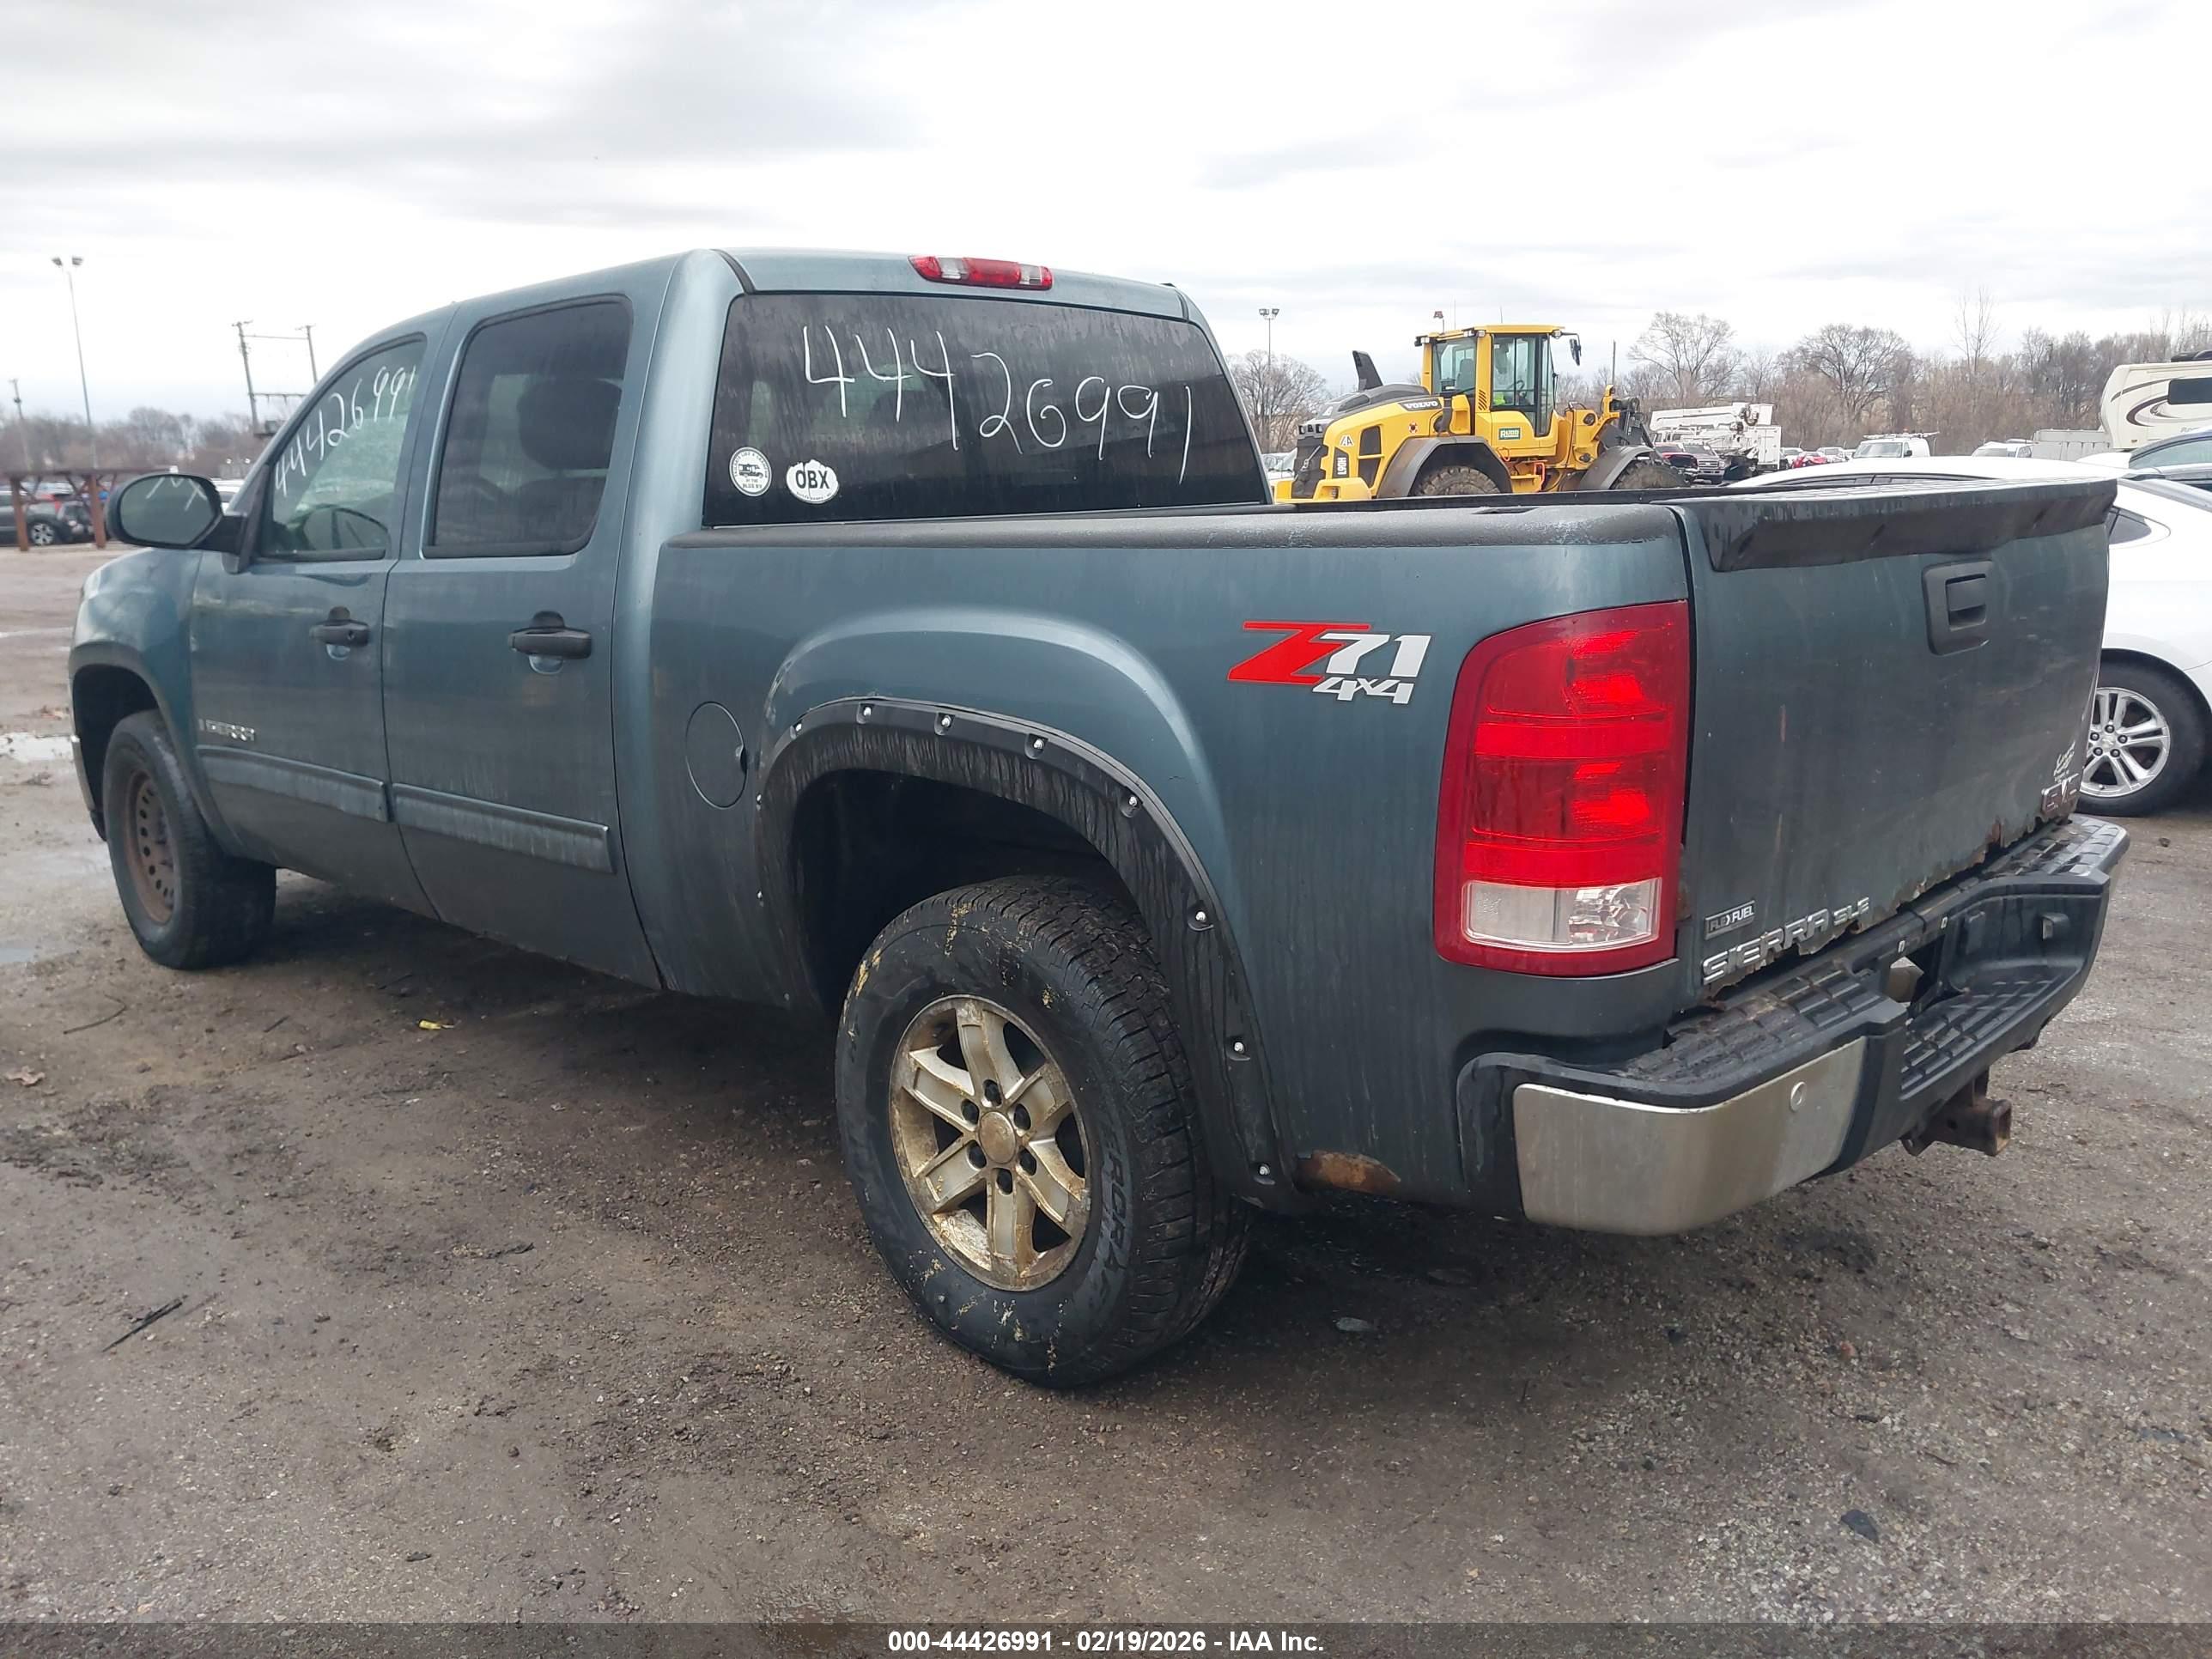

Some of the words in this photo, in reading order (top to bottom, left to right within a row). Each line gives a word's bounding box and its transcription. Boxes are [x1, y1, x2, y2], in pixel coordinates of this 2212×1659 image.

[275, 365, 417, 497] 44426991
[803, 325, 1191, 485] 44426991
[795, 470, 830, 489] OBX
[1336, 457, 1347, 476] L90H
[1227, 620, 1431, 684] Z71
[1703, 908, 1829, 985] SIERRA
[1833, 896, 1869, 927] SLE
